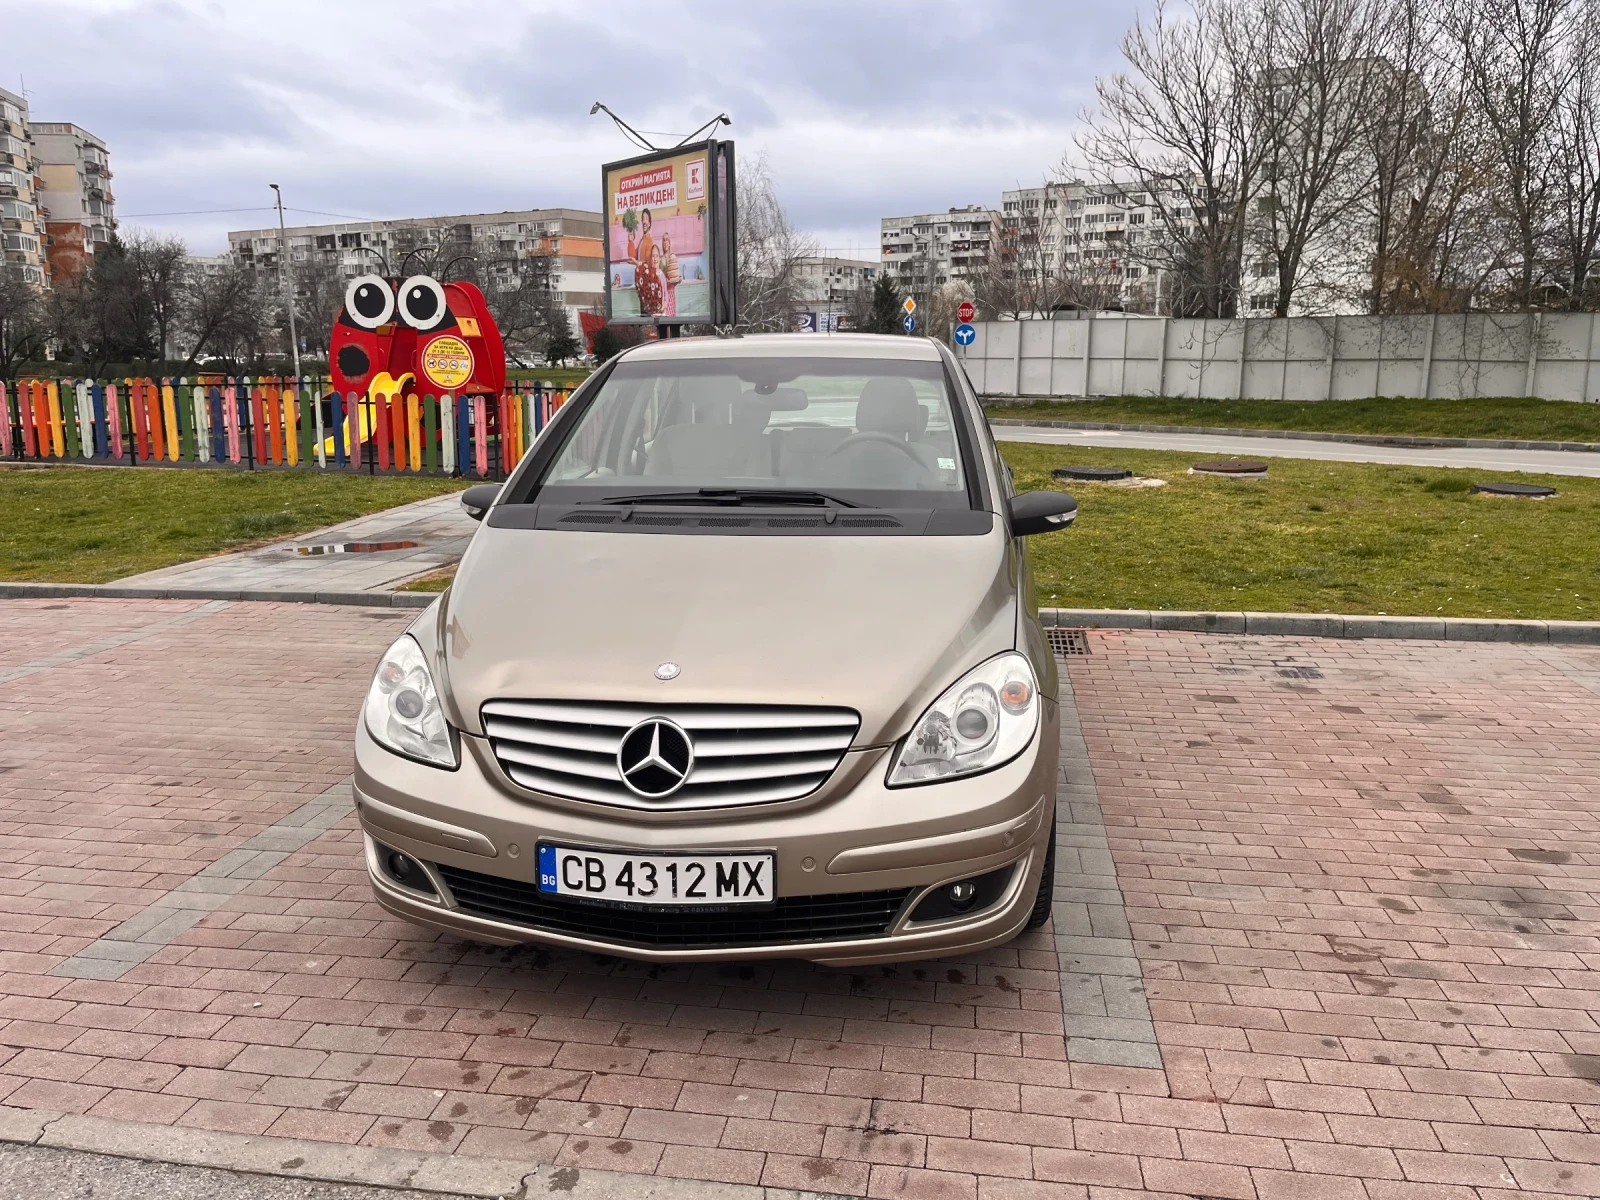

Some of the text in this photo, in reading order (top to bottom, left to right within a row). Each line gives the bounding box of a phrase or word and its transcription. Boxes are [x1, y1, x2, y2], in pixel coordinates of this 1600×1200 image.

[621, 169, 671, 190] ОТКРИЙ МАГИЯТА
[617, 197, 628, 209] НА
[958, 309, 973, 317] STOP
[541, 873, 556, 886] BG
[562, 855, 765, 898] CB 4312 MX
